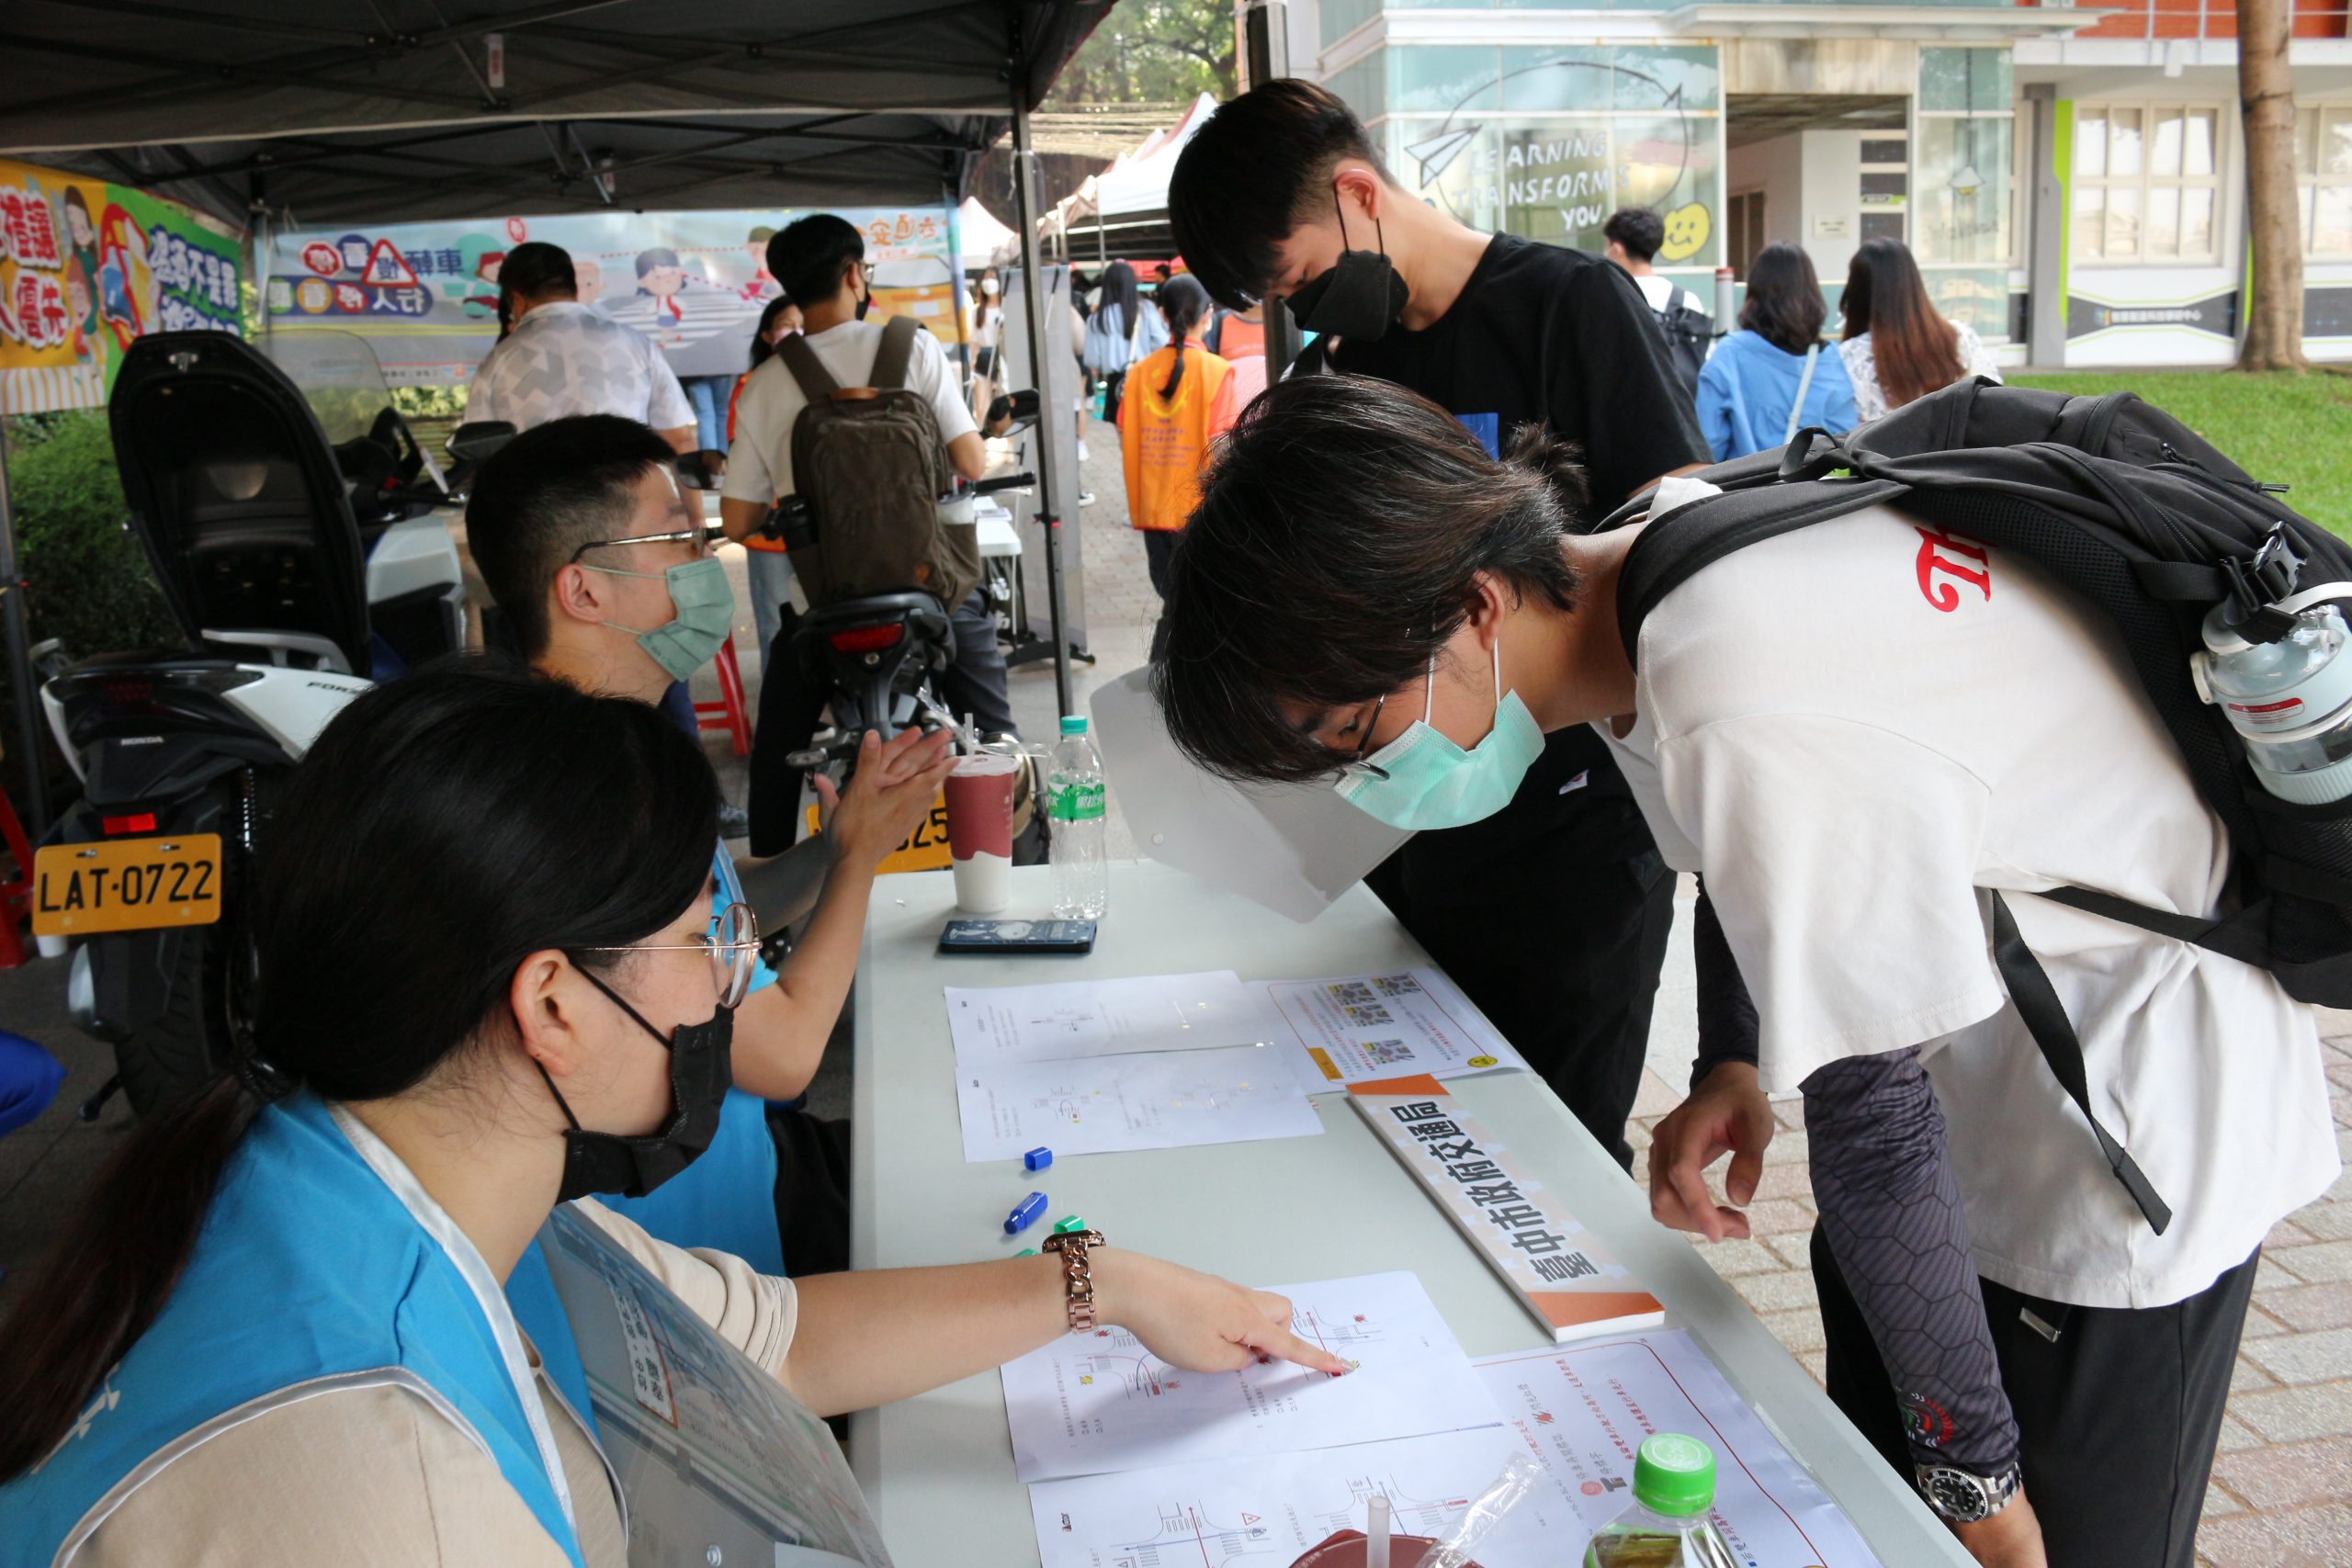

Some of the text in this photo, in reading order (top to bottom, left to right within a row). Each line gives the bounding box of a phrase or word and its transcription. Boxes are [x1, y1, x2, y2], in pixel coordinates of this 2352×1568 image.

[1468, 130, 1608, 176] LEARNING
[1453, 165, 1631, 210] TRANSFORMS
[1389, 1101, 1599, 1282] 臺中市政府交通局
